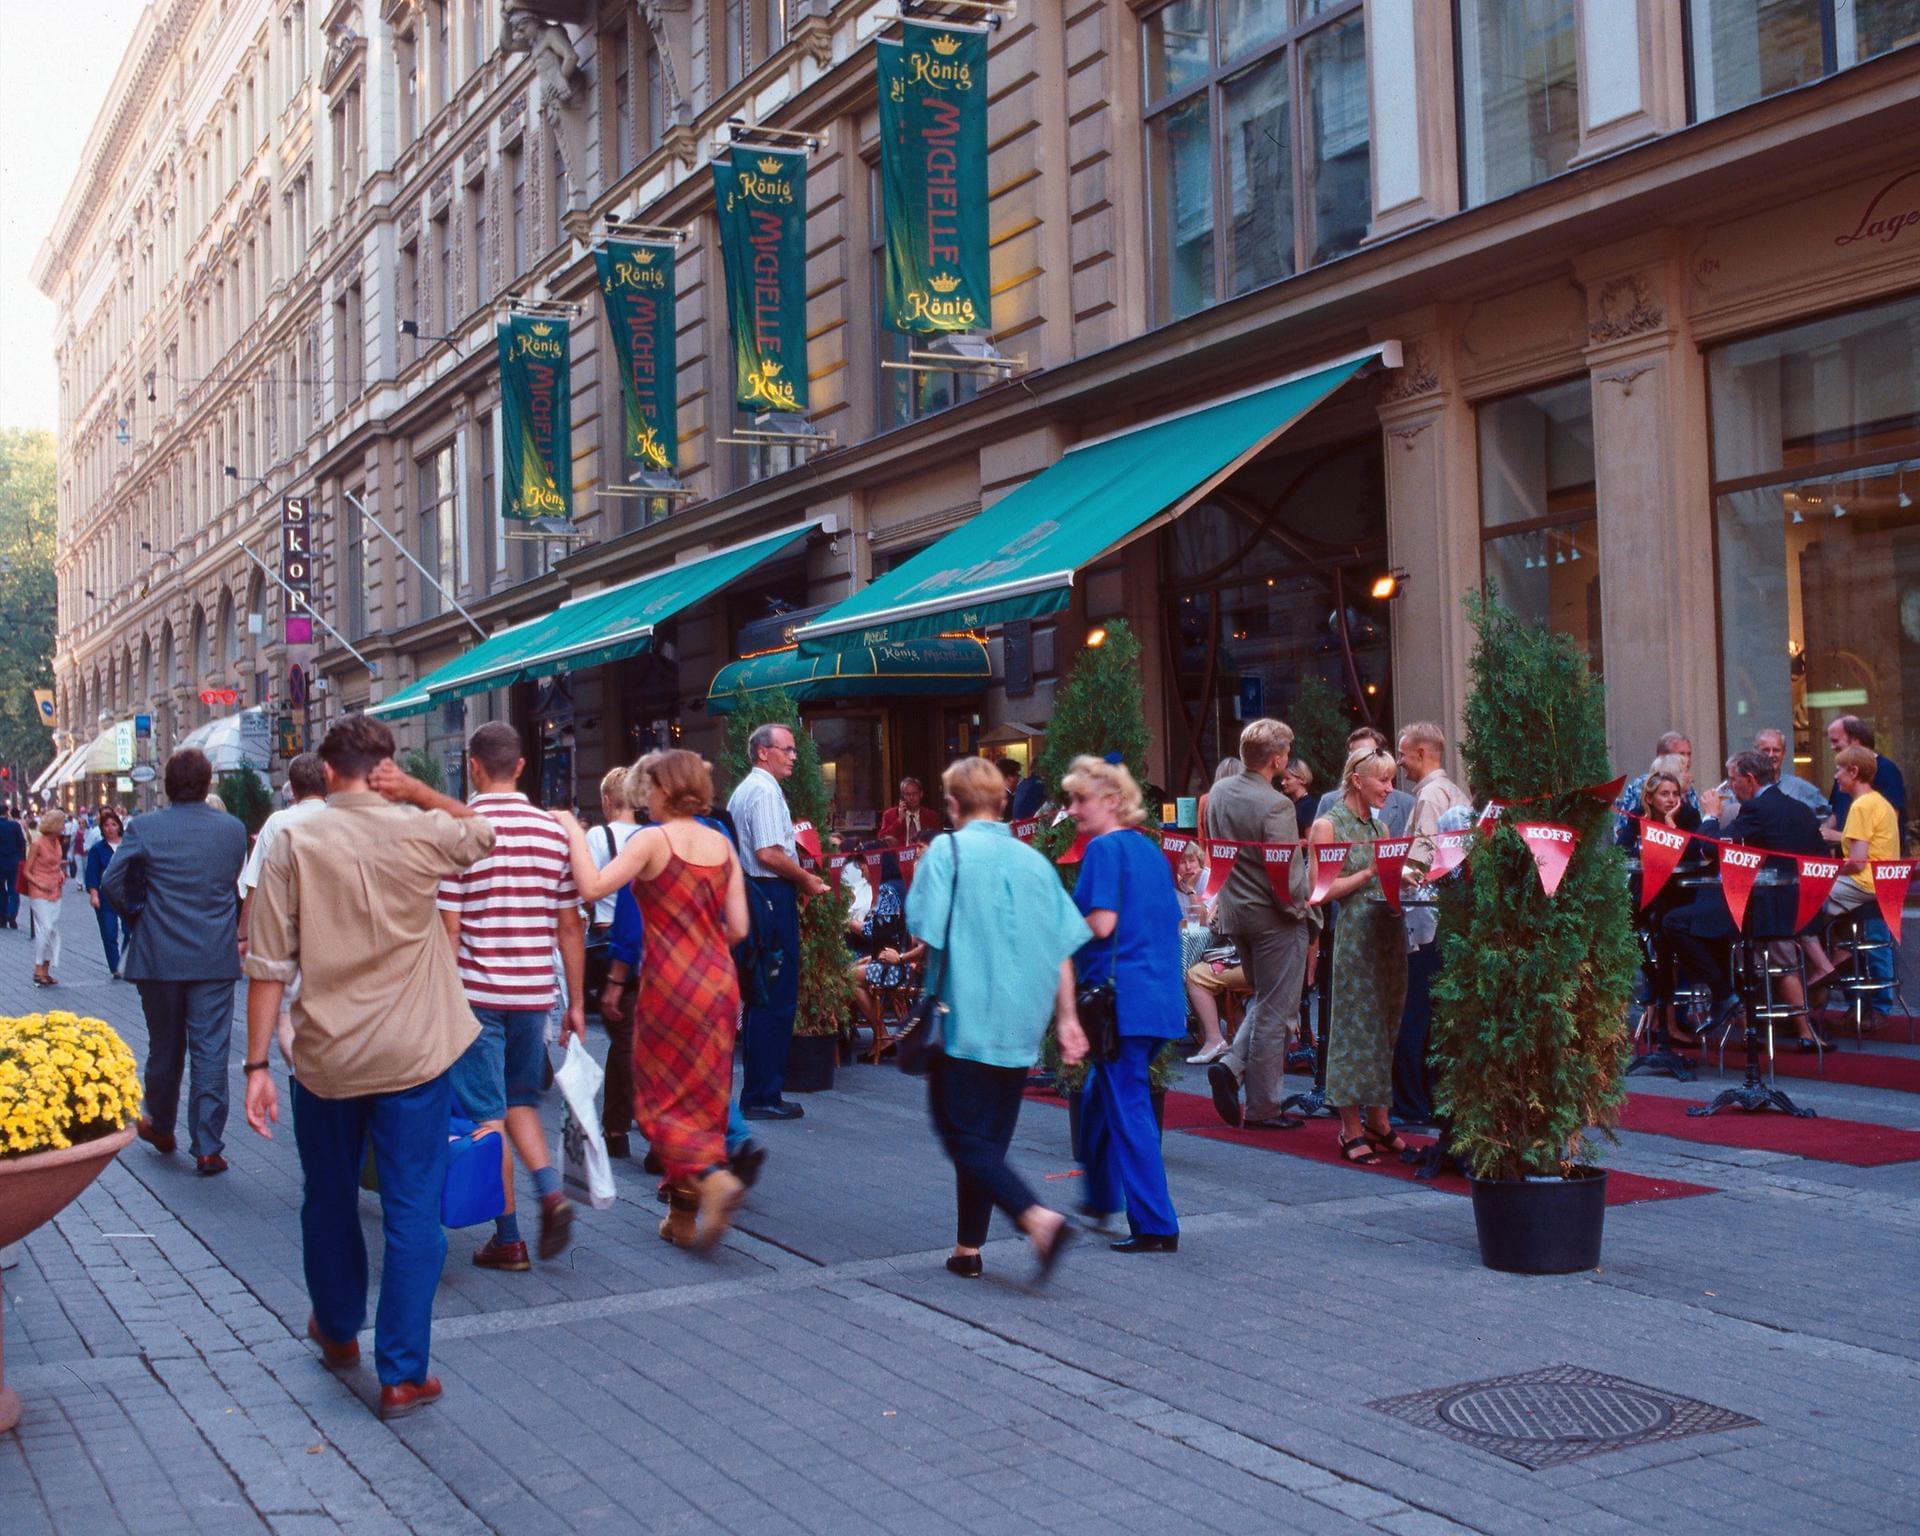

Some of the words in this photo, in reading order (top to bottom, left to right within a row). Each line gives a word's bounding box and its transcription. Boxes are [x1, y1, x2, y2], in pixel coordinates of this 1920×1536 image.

[908, 52, 972, 90] König
[737, 171, 793, 204] König
[921, 98, 960, 267] MICHELLE
[615, 263, 665, 290] König
[749, 210, 783, 354] MICHELLE
[905, 290, 976, 326] König
[516, 336, 562, 360] König
[1525, 827, 1573, 843] KOFF
[1645, 826, 1684, 850] KOFF
[1163, 838, 1187, 852] KOFF
[1212, 845, 1238, 860] KOFF
[1378, 843, 1409, 858] KOFF
[899, 848, 915, 862] KOFF
[1265, 849, 1291, 863] KOFF
[1320, 848, 1347, 863] KOFF
[1723, 848, 1761, 868] KOFF
[1801, 862, 1839, 878] KOFF
[1875, 865, 1911, 880] KOFF
